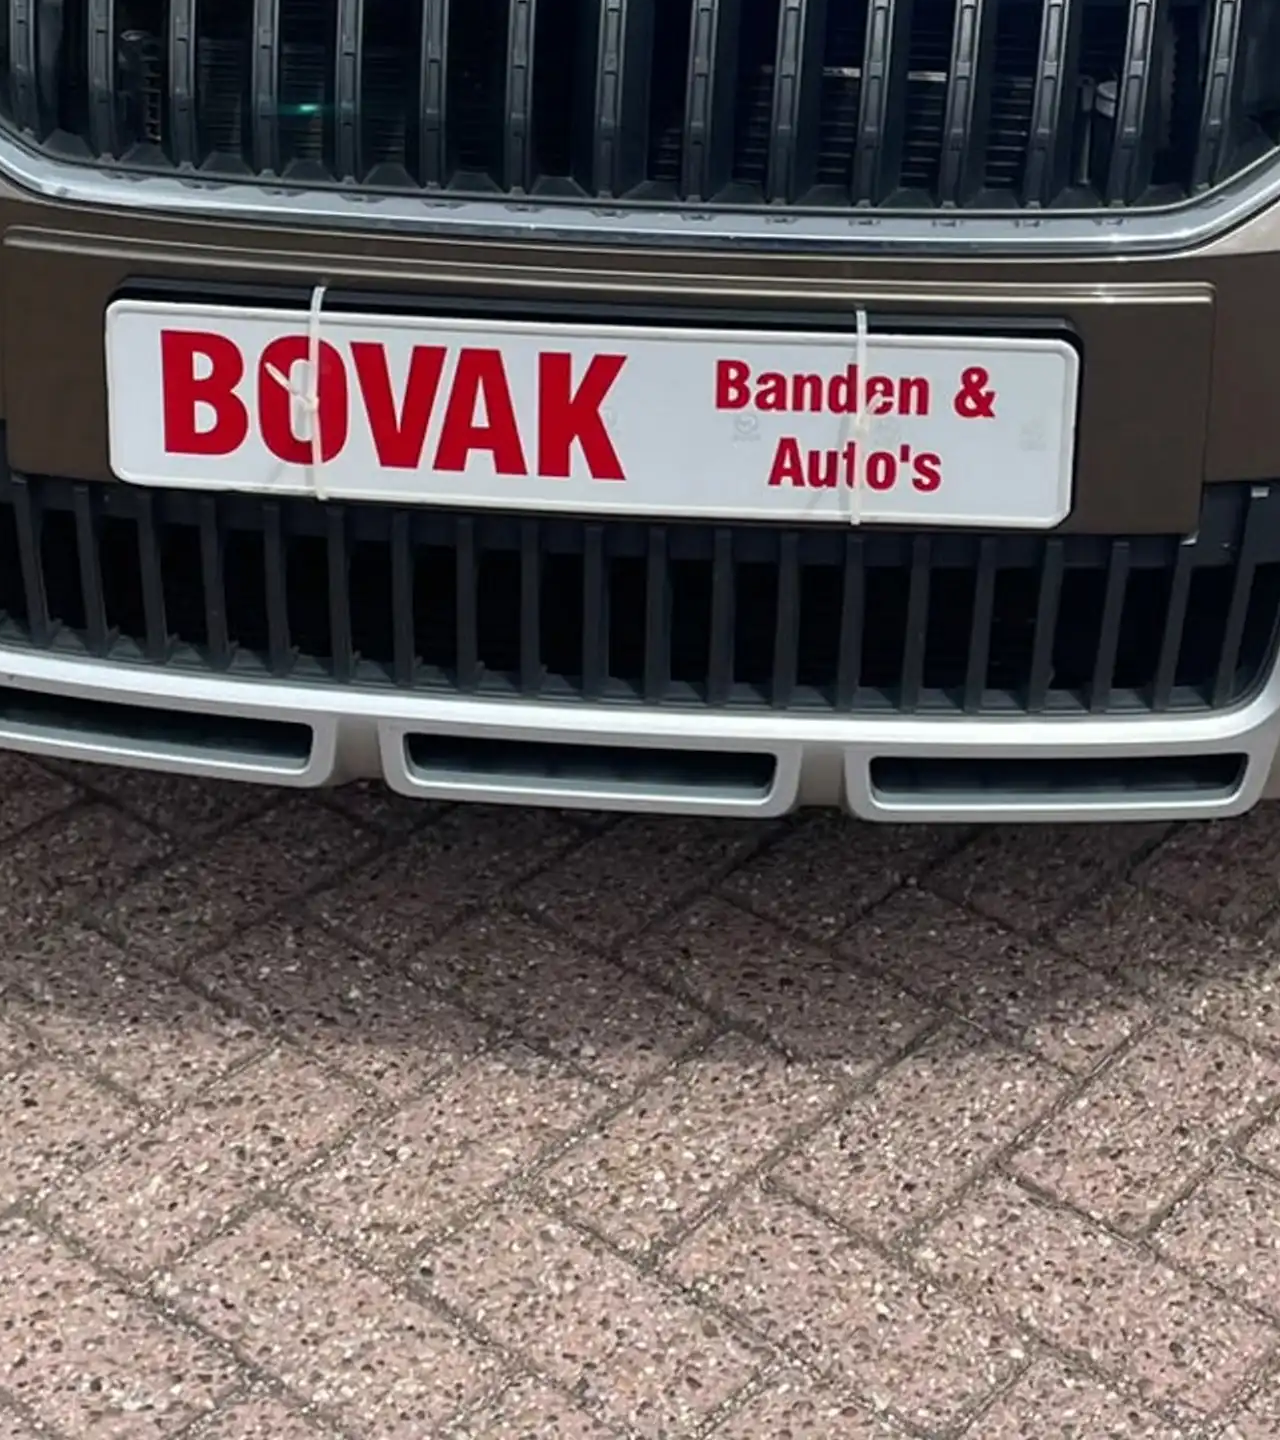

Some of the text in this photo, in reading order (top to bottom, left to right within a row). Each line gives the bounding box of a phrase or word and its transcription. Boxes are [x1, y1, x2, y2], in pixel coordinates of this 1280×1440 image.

[160, 328, 627, 481] BOVAK
[715, 359, 996, 419] Banden &
[768, 436, 942, 492] Auto's
